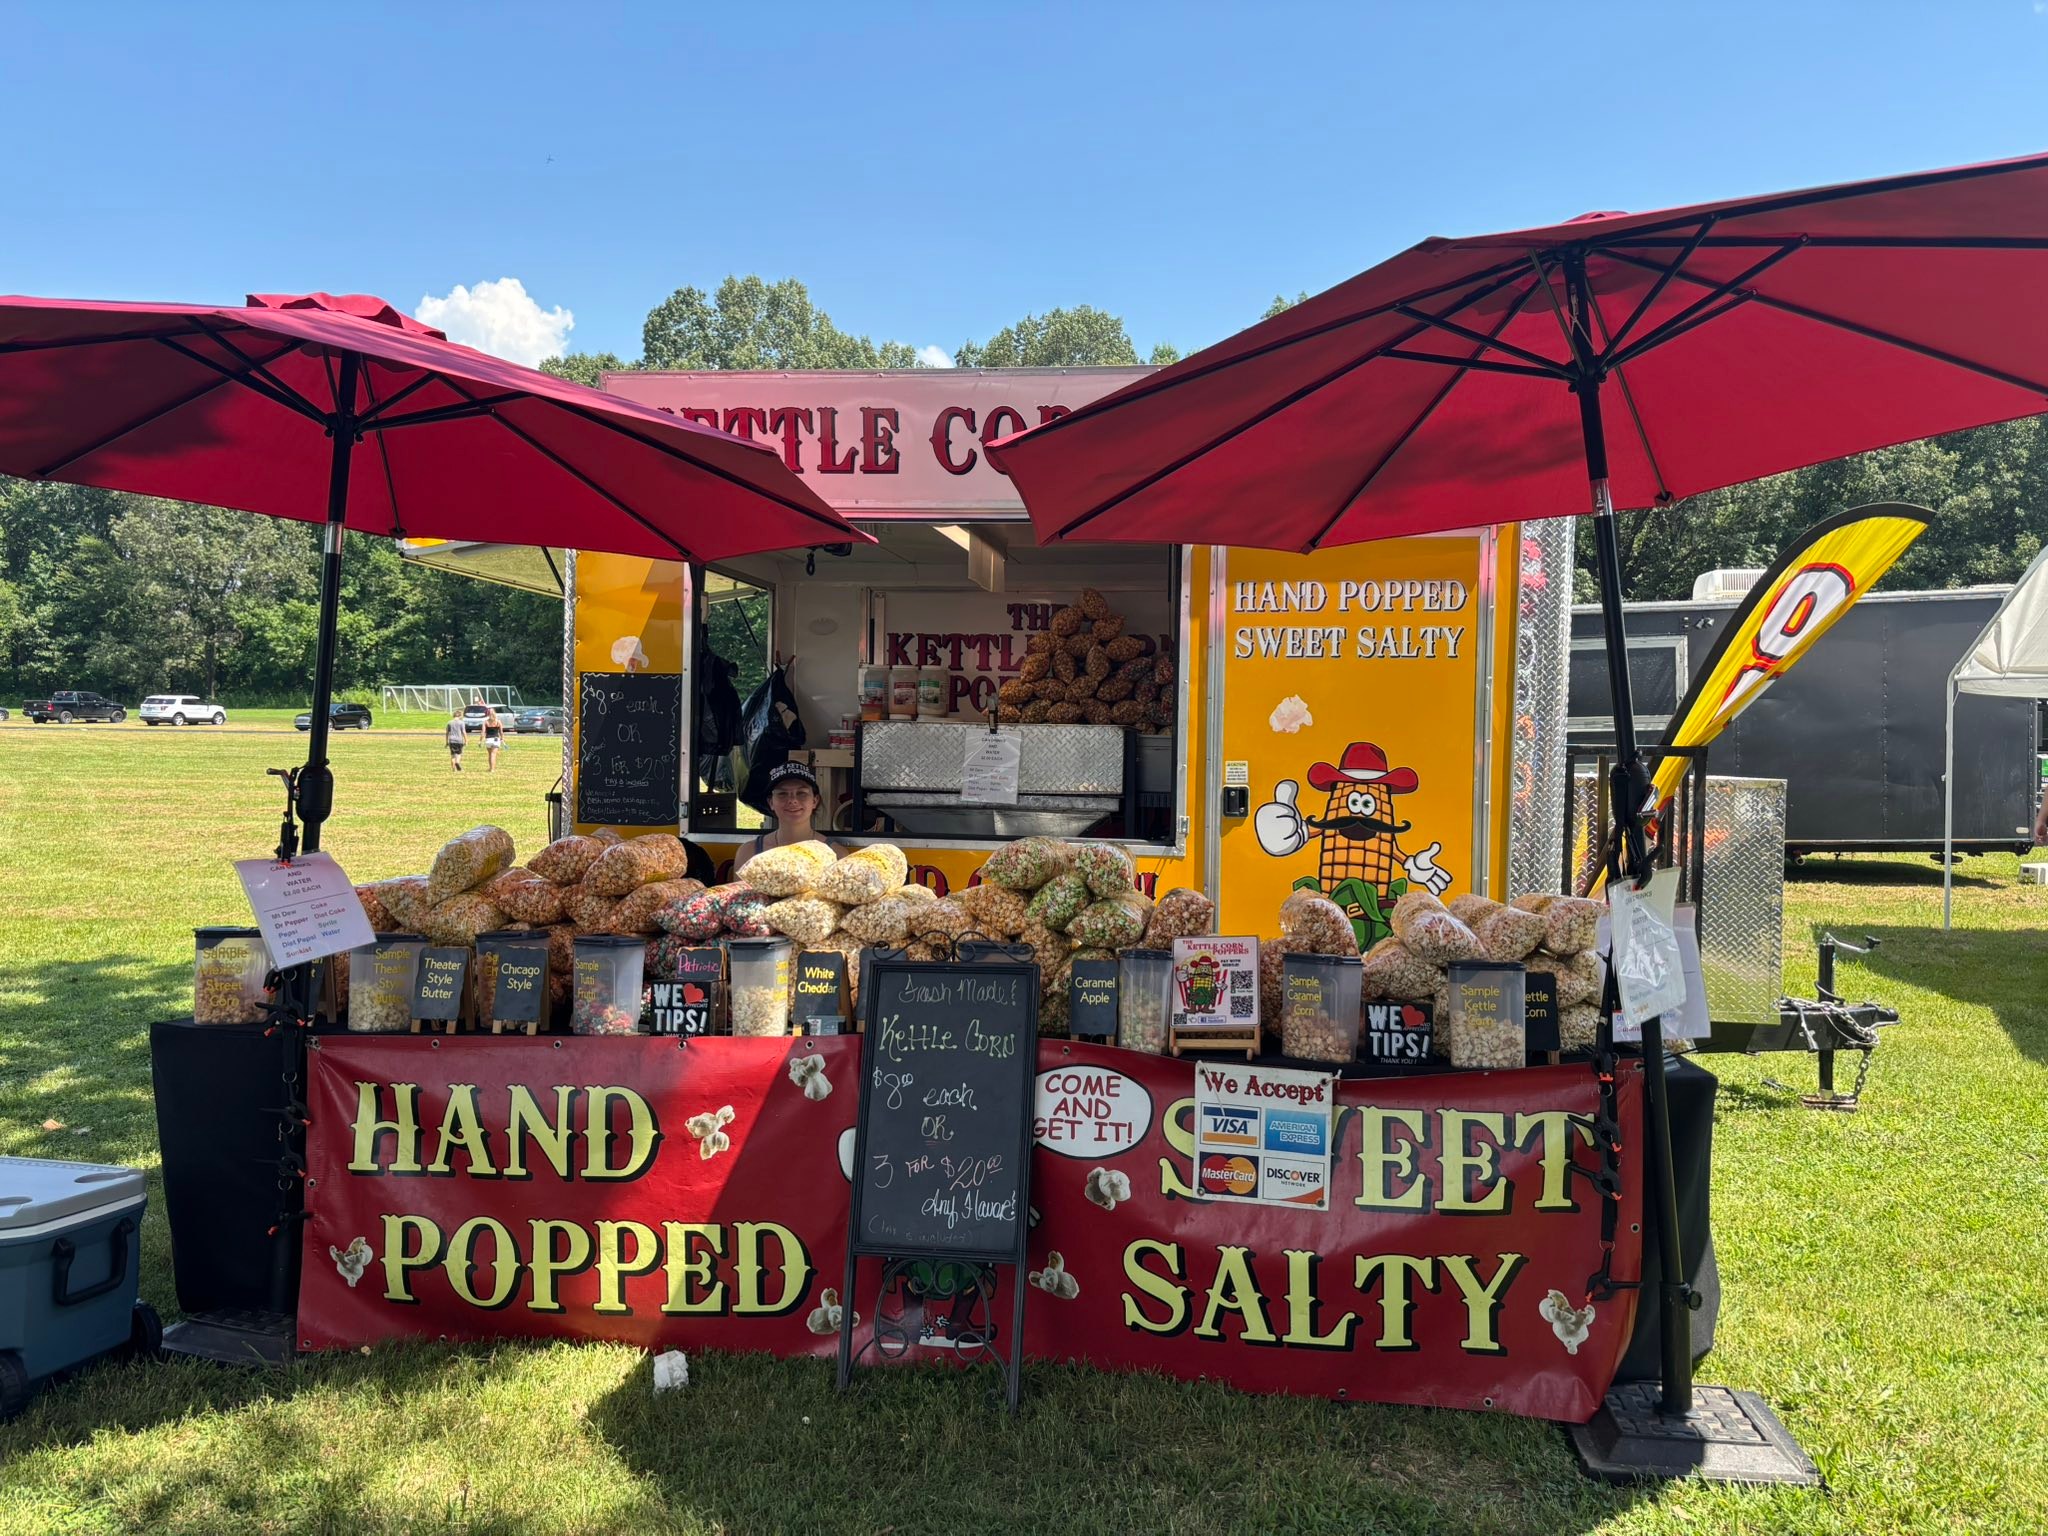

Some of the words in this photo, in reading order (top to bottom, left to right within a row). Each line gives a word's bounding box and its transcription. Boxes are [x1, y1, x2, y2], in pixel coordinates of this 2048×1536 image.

[1235, 580, 1328, 612] HAND
[1338, 580, 1468, 612] POPPED
[1235, 627, 1347, 658] SWEET
[1356, 627, 1465, 658] SALTY
[887, 632, 1037, 671] KETTL
[617, 723, 642, 743] OR
[592, 755, 602, 775] 3
[611, 755, 630, 774] FOR
[786, 763, 810, 772] KETTLE
[286, 877, 312, 887] WATER
[302, 884, 322, 893] EACH
[311, 902, 327, 910] Coke
[314, 911, 328, 919] Diet
[329, 906, 346, 916] Coke
[282, 909, 296, 918] Dew
[284, 917, 309, 928] Pepper
[318, 919, 337, 929] Sprite
[278, 929, 298, 938] Pepsi
[321, 928, 341, 937] Water
[282, 940, 297, 948] Diet
[298, 934, 316, 944] Pepsi
[286, 947, 312, 958] Sunkist
[375, 948, 410, 960] Sample
[424, 958, 462, 971] Theater
[501, 963, 540, 977] Chicago
[575, 958, 599, 973] Sample
[677, 953, 721, 974] Patriotic
[427, 973, 453, 985] Style
[579, 973, 596, 985] Tutti
[804, 966, 835, 979] White
[205, 979, 243, 992] Street
[507, 978, 532, 992] Style
[797, 981, 838, 993] Cheddar
[1075, 977, 1116, 988] Caramel
[1289, 975, 1319, 988] Sample
[421, 987, 453, 999] Butter
[577, 987, 597, 999] Frutti
[653, 984, 683, 1007] WE
[899, 974, 952, 1006] Fresh
[1287, 989, 1322, 1001] Caramel
[1460, 984, 1500, 999] Sample
[1524, 990, 1549, 1002] ettle
[1080, 991, 1110, 1005] Apple
[1294, 1004, 1315, 1017] Corn
[1464, 1000, 1497, 1012] Kettle
[654, 1009, 707, 1034] TIPS!
[1368, 1005, 1402, 1031] WE
[1467, 1014, 1495, 1028] Corn
[1369, 1031, 1429, 1059] TIPS!
[1045, 1073, 1122, 1098] COME
[1204, 1071, 1238, 1094] We
[1244, 1075, 1324, 1105] Accept
[923, 1083, 977, 1110] each
[1053, 1098, 1112, 1119] AND
[347, 1080, 664, 1182] HAND
[922, 1115, 954, 1141] OR
[1033, 1118, 1083, 1140] GET
[1093, 1121, 1133, 1143] IT!
[1212, 1117, 1249, 1135] VISA
[1270, 1120, 1317, 1134] AMERICAN
[1280, 1131, 1320, 1145] EXPRESS
[873, 1154, 894, 1189] 3
[905, 1154, 935, 1178] FOR
[1202, 1167, 1256, 1182] MasterCard
[1266, 1167, 1321, 1184] DISCOVER
[1280, 1180, 1306, 1188] NETWORK
[921, 1188, 959, 1229] Any
[379, 1213, 817, 1317] POPPED
[1121, 1238, 1529, 1356] SALTY
